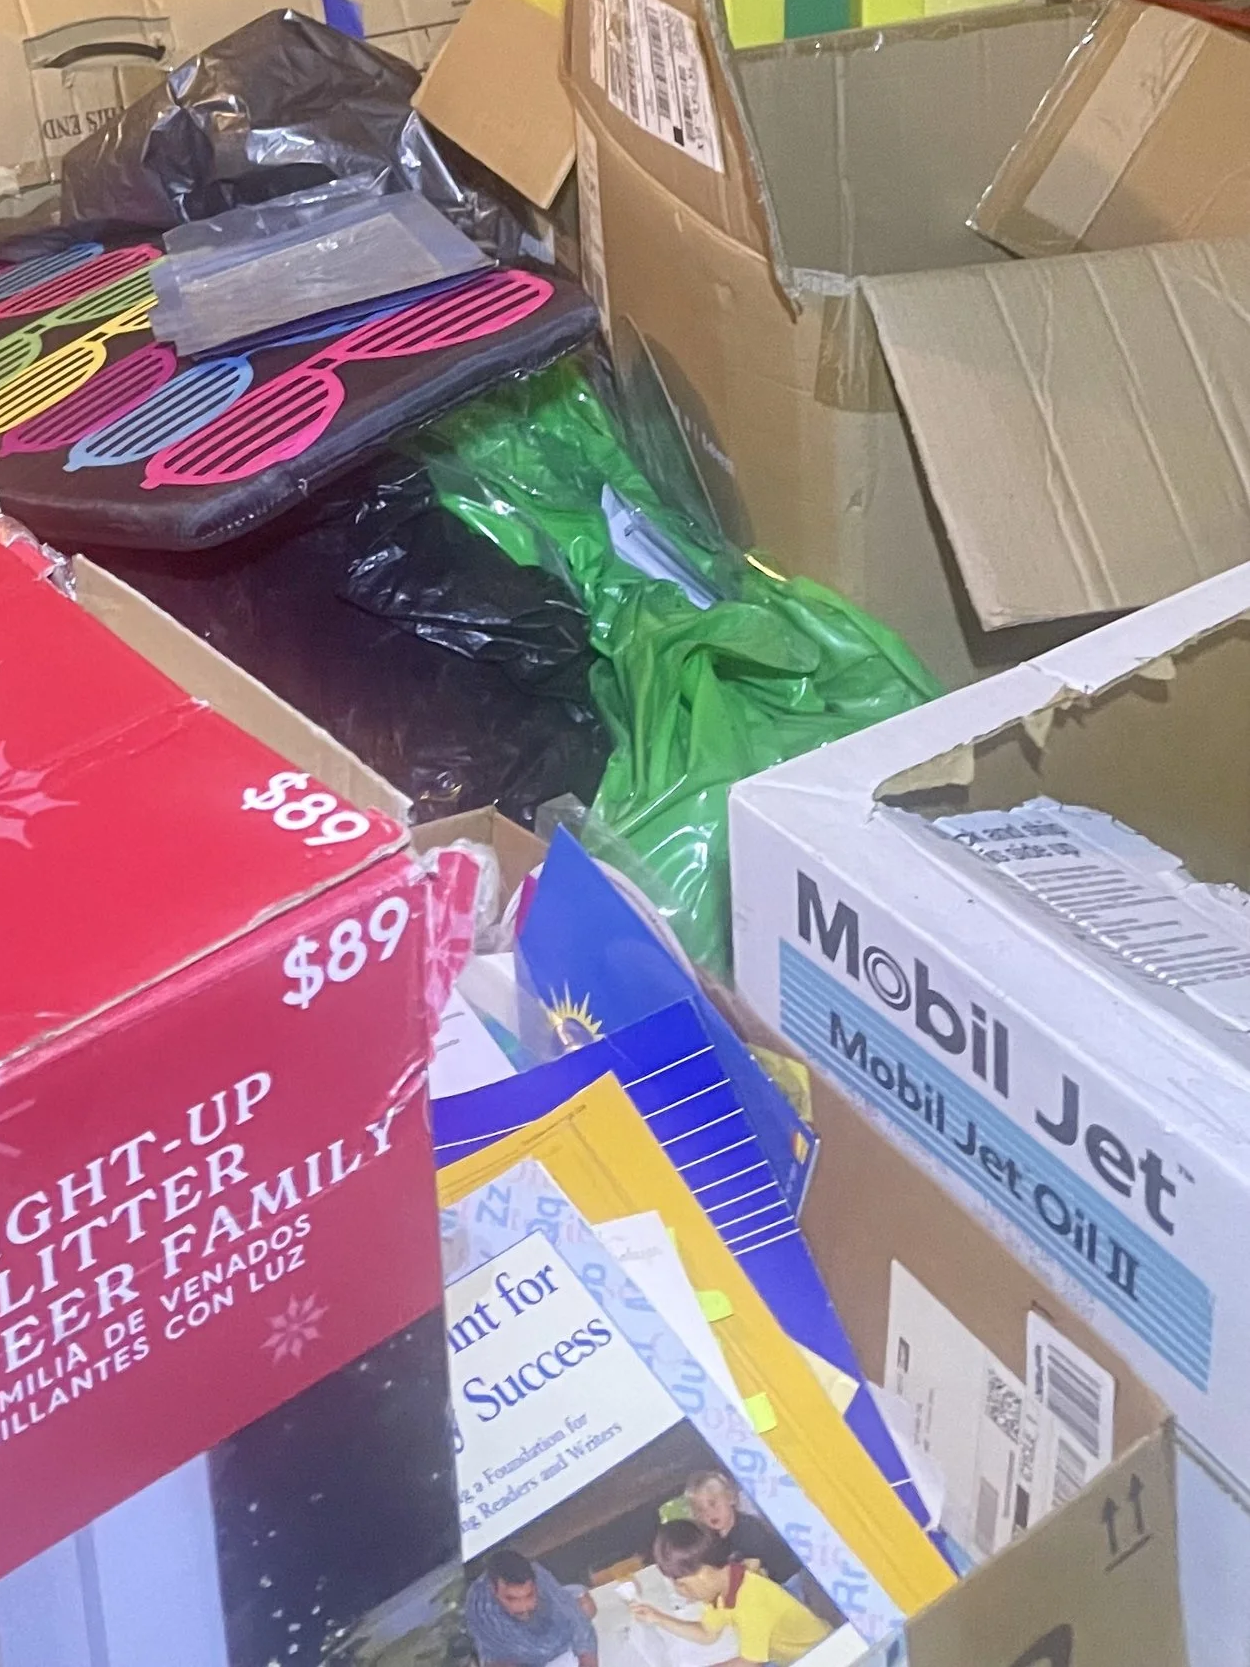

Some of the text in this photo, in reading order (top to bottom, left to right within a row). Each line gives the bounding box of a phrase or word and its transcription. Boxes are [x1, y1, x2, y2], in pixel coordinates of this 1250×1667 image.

[44, 115, 81, 139] END
[242, 771, 370, 848] $89
[281, 896, 410, 1009] $89
[796, 868, 1010, 1100] Mobil
[160, 1104, 406, 1280] FAMILY
[829, 1009, 1143, 1302] Mobil Jet Oil II
[103, 1310, 146, 1351] DE
[160, 1211, 313, 1313] VENADOS
[165, 1288, 234, 1342] CON
[248, 1242, 307, 1294] LUZ
[494, 1260, 561, 1318] for
[462, 1316, 614, 1424] Success
[477, 1475, 540, 1519] Readers
[537, 1451, 570, 1482] and
[566, 1421, 623, 1461] Writers
[481, 1427, 567, 1486] Foundation
[562, 1411, 590, 1434] for
